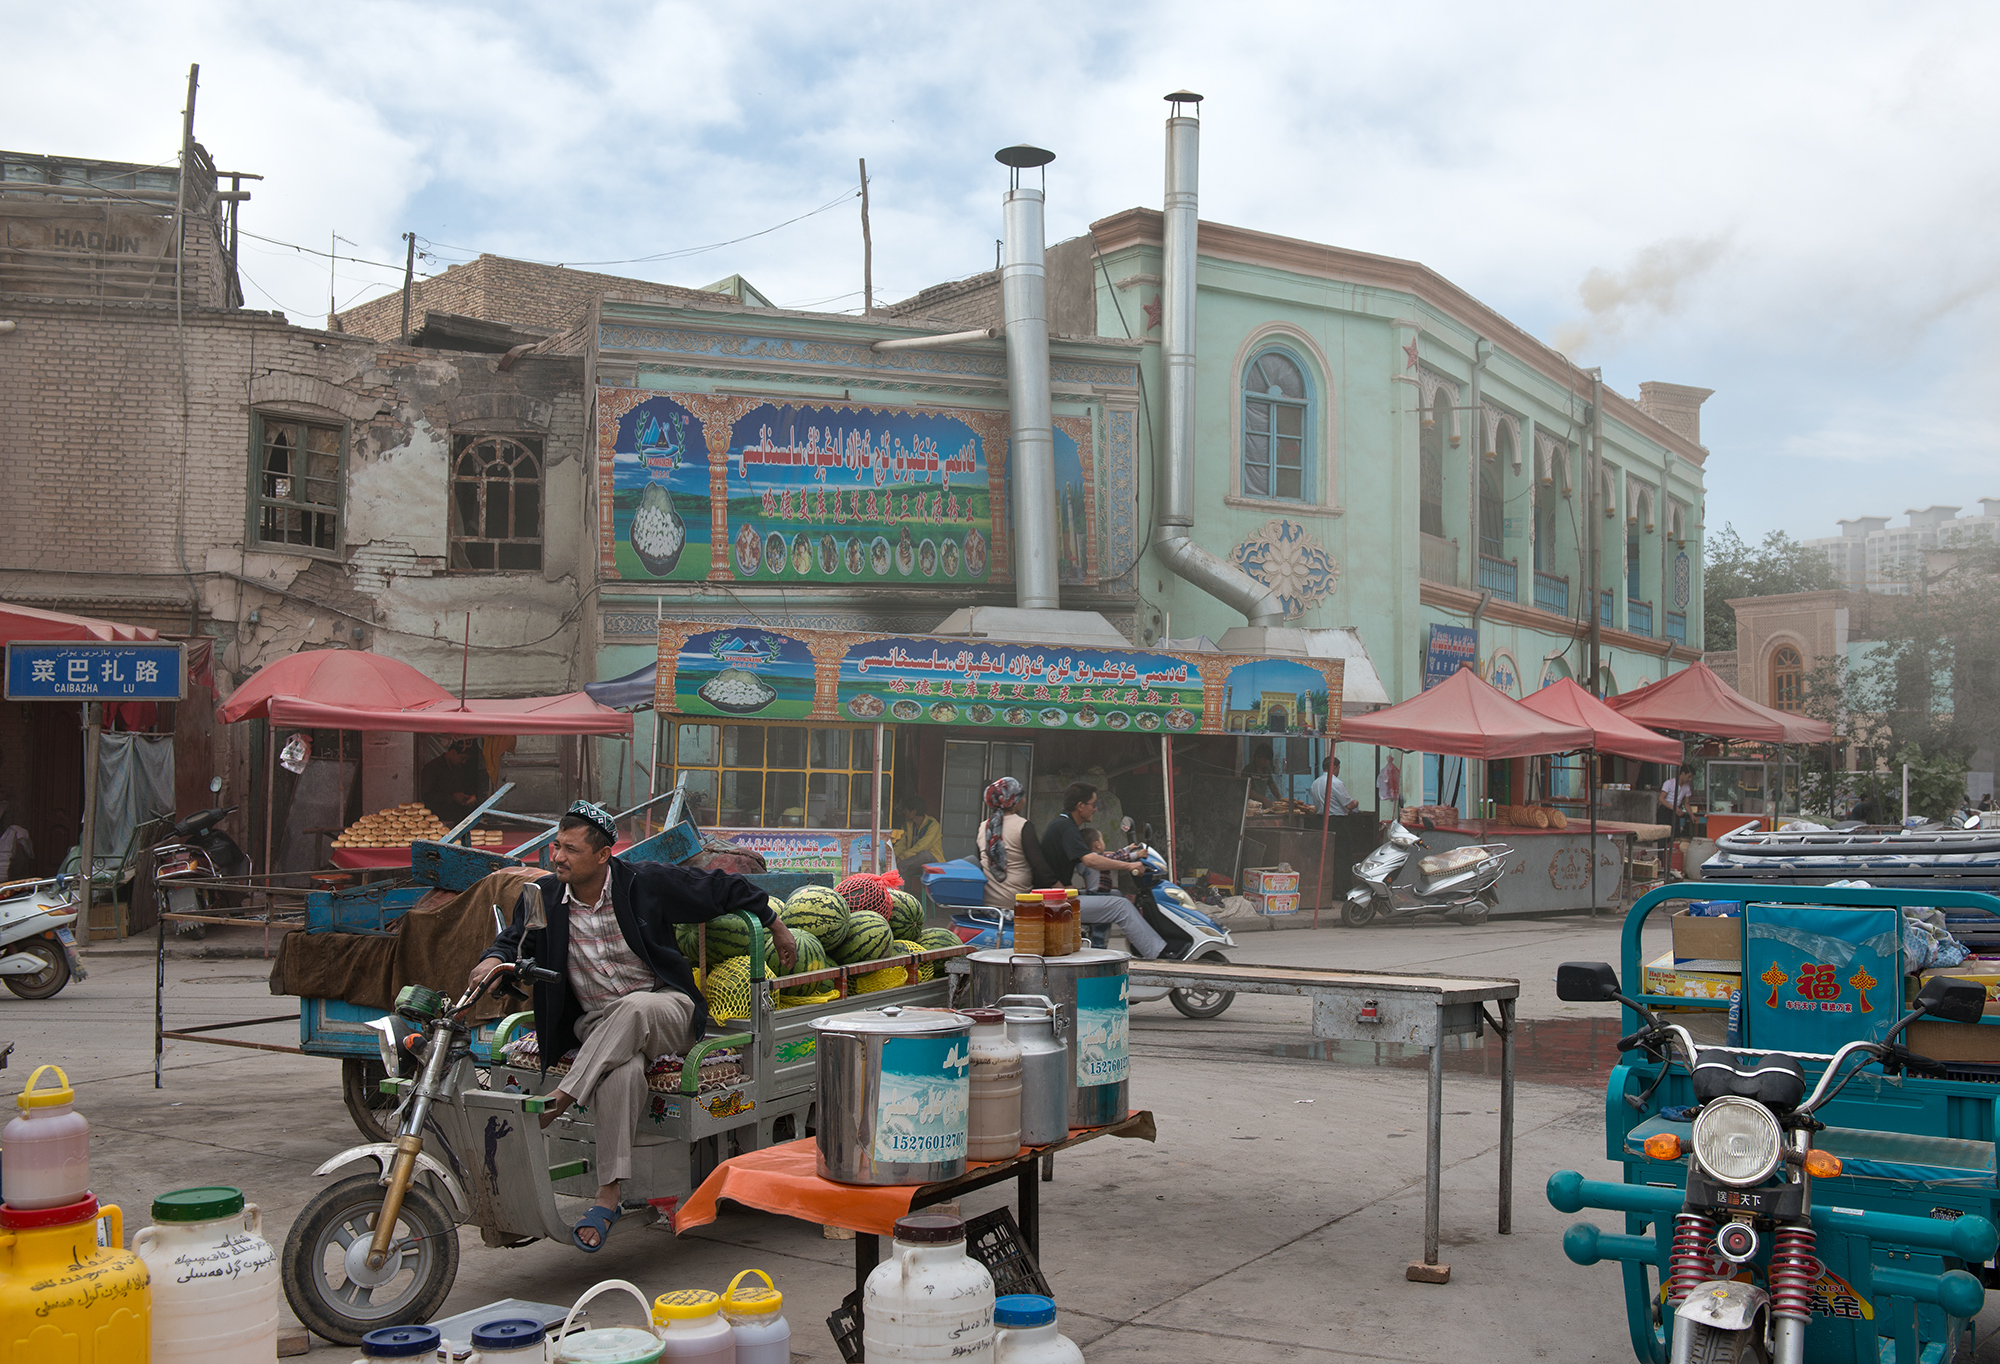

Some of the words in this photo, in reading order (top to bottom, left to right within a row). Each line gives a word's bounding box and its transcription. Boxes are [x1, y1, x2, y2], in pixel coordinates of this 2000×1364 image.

[54, 228, 139, 253] HAOJIN
[32, 659, 159, 682] 菜巴扎路
[54, 683, 98, 693] CAIBAZHA
[123, 683, 135, 693] LU
[1796, 962, 1841, 1001] 福
[892, 1131, 964, 1151] 15276012707
[1716, 1191, 1761, 1206] 送福天下
[1806, 1284, 1845, 1293] ENDI
